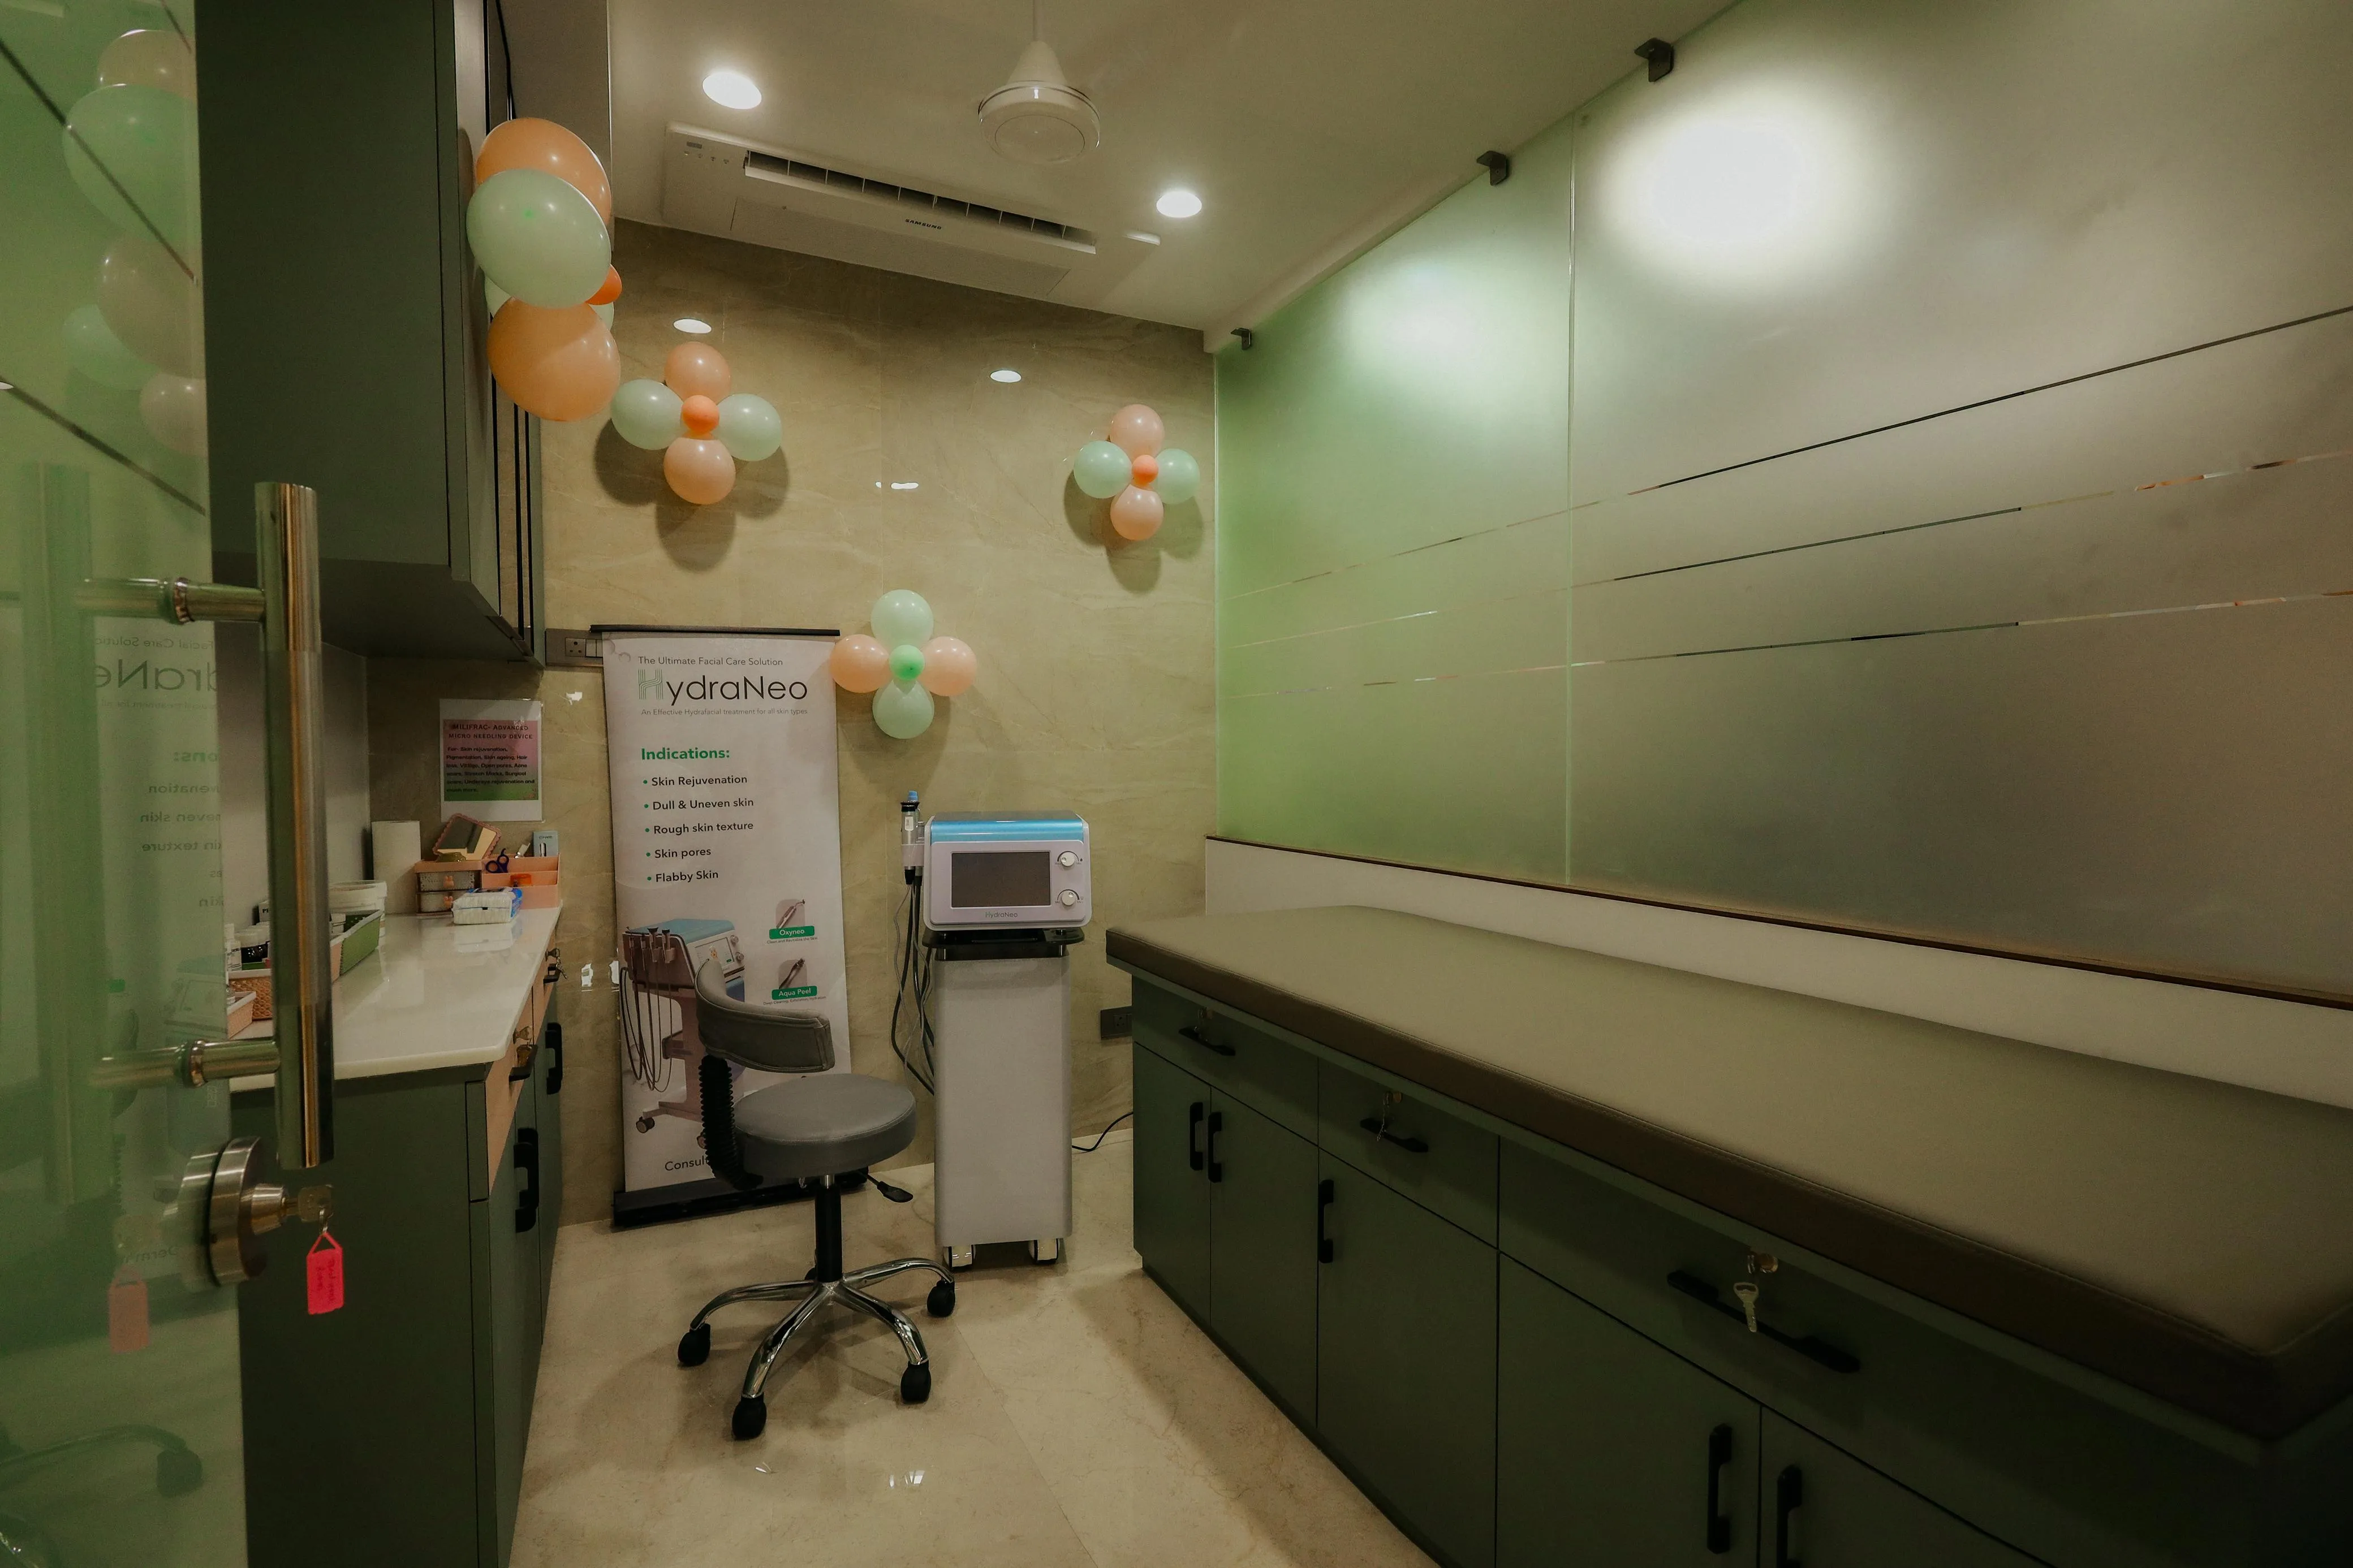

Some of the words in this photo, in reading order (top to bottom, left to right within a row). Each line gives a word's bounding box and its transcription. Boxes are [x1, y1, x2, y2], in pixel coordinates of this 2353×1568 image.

[638, 656, 656, 665] The
[658, 656, 696, 666] Ultimate
[699, 657, 723, 666] Facial
[726, 658, 746, 666] Care
[749, 658, 783, 666] Solution
[639, 669, 807, 706] HydraNeo
[684, 709, 722, 717] Hydrafacial
[642, 747, 730, 760] Indications:
[652, 777, 674, 786] Skin
[679, 775, 747, 787] Rejuvenation
[653, 801, 674, 810] Dull
[734, 798, 753, 806] skin
[654, 824, 689, 835] Rough
[693, 823, 713, 832] skin
[655, 849, 677, 858] Skin
[682, 849, 711, 859] pores
[656, 872, 693, 883] Flabby
[696, 870, 718, 879] Skin
